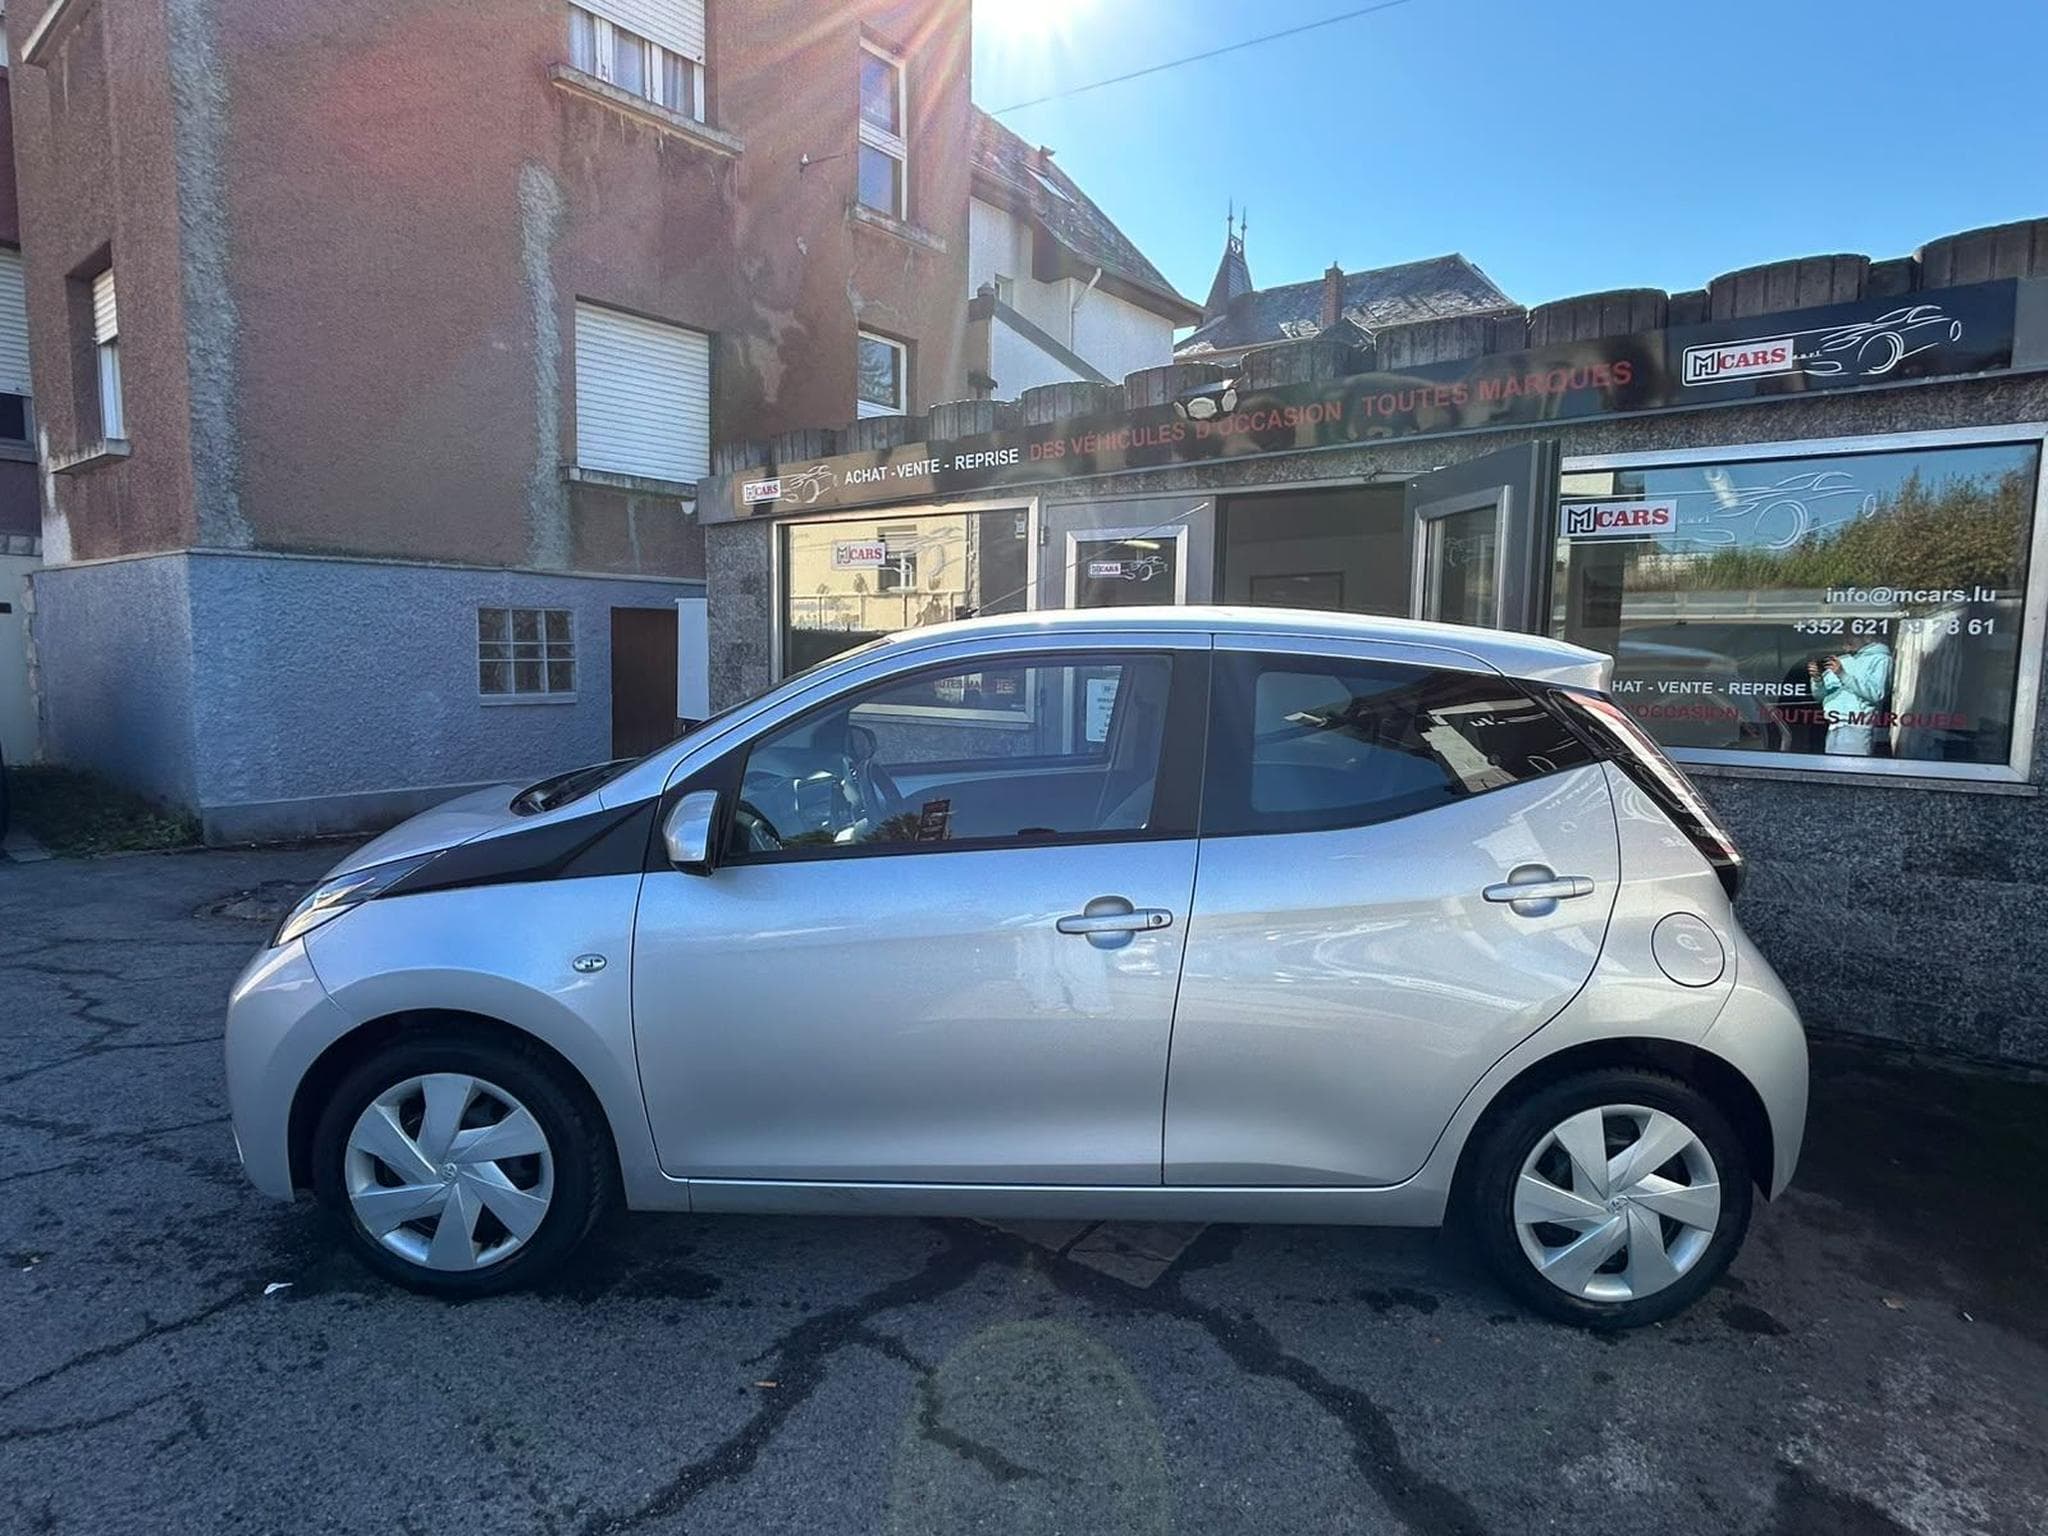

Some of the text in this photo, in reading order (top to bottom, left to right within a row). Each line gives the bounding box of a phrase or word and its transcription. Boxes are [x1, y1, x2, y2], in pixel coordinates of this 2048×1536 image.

[1030, 360, 1633, 462] DES VÉHICULES D'OCCASION TOUTES MARQUES
[844, 466, 888, 485] ACHAT
[896, 459, 940, 478] VENTE
[954, 448, 1019, 470] REPRISE
[1826, 585, 1997, 606] info@mcars.lu
[1793, 618, 1845, 635] +352
[1851, 618, 1889, 635] 621
[1967, 618, 1995, 636] 61
[1657, 681, 1714, 694] VENTE
[1728, 682, 1807, 696] REPRISE
[1849, 710, 1970, 729] MARQUES
